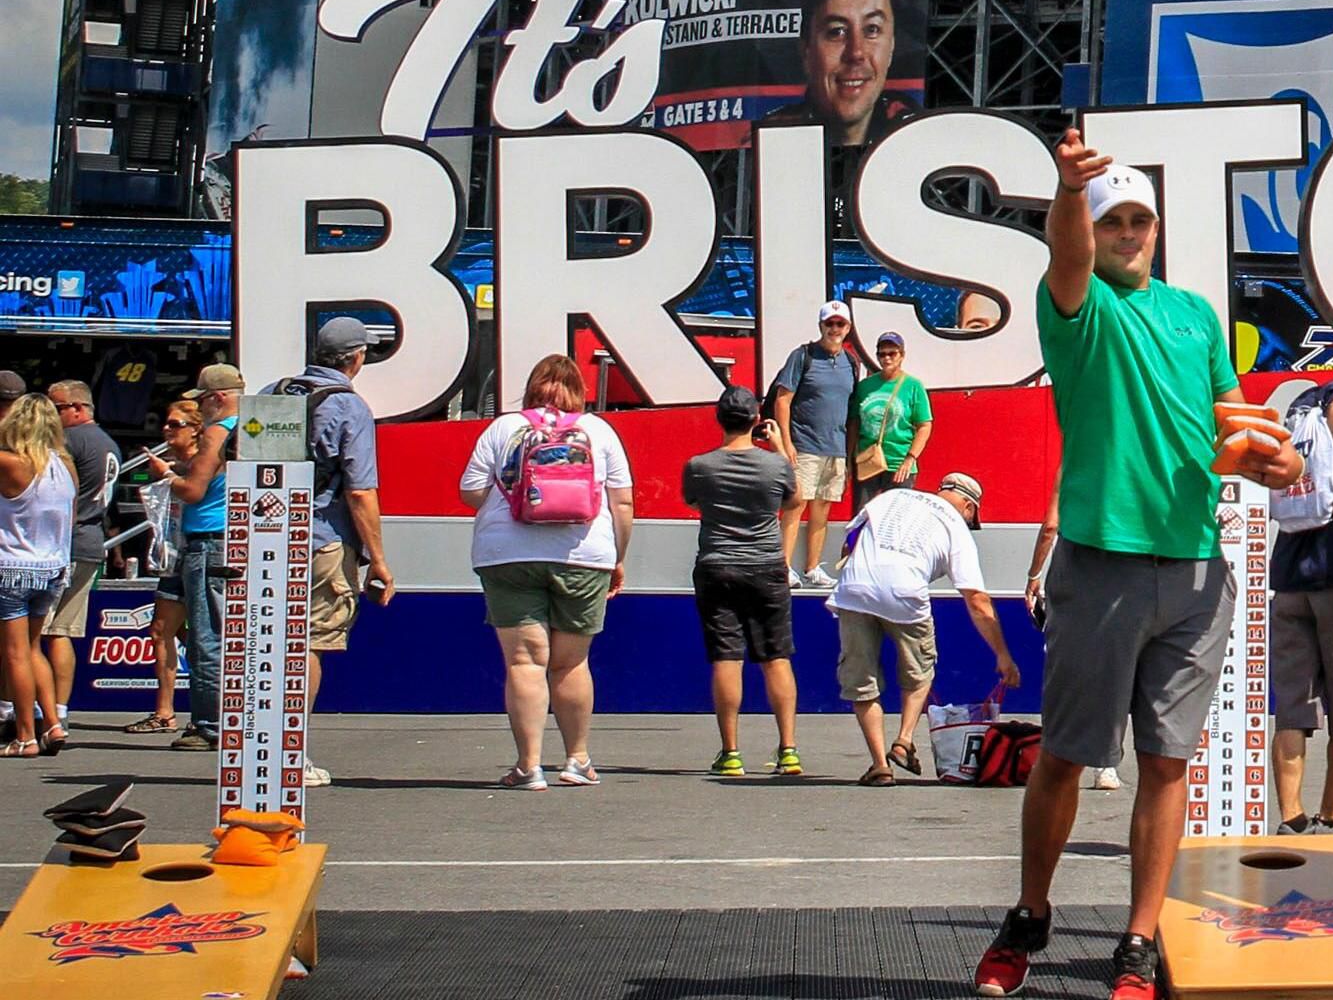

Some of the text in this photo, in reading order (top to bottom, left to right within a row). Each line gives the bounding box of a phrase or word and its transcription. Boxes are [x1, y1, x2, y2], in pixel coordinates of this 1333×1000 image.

[712, 19, 722, 36] &
[727, 13, 799, 36] TERRACE
[664, 98, 743, 127] GATE 3 & 4
[116, 362, 146, 382] 48
[266, 423, 302, 431] MEADE
[263, 469, 276, 486] 5
[1222, 486, 1235, 501] 4
[229, 510, 247, 523] 20
[290, 511, 309, 523] 20
[229, 548, 247, 560] 18
[288, 585, 306, 597] 16
[90, 636, 157, 665] FOOD
[225, 660, 244, 671] 12
[287, 661, 305, 672] 12
[225, 678, 243, 690] 11
[228, 714, 239, 727] 9
[227, 752, 238, 764] 7
[288, 753, 298, 765] 7
[226, 770, 237, 783] 6
[287, 771, 298, 784] 6
[1250, 805, 1260, 818] 4
